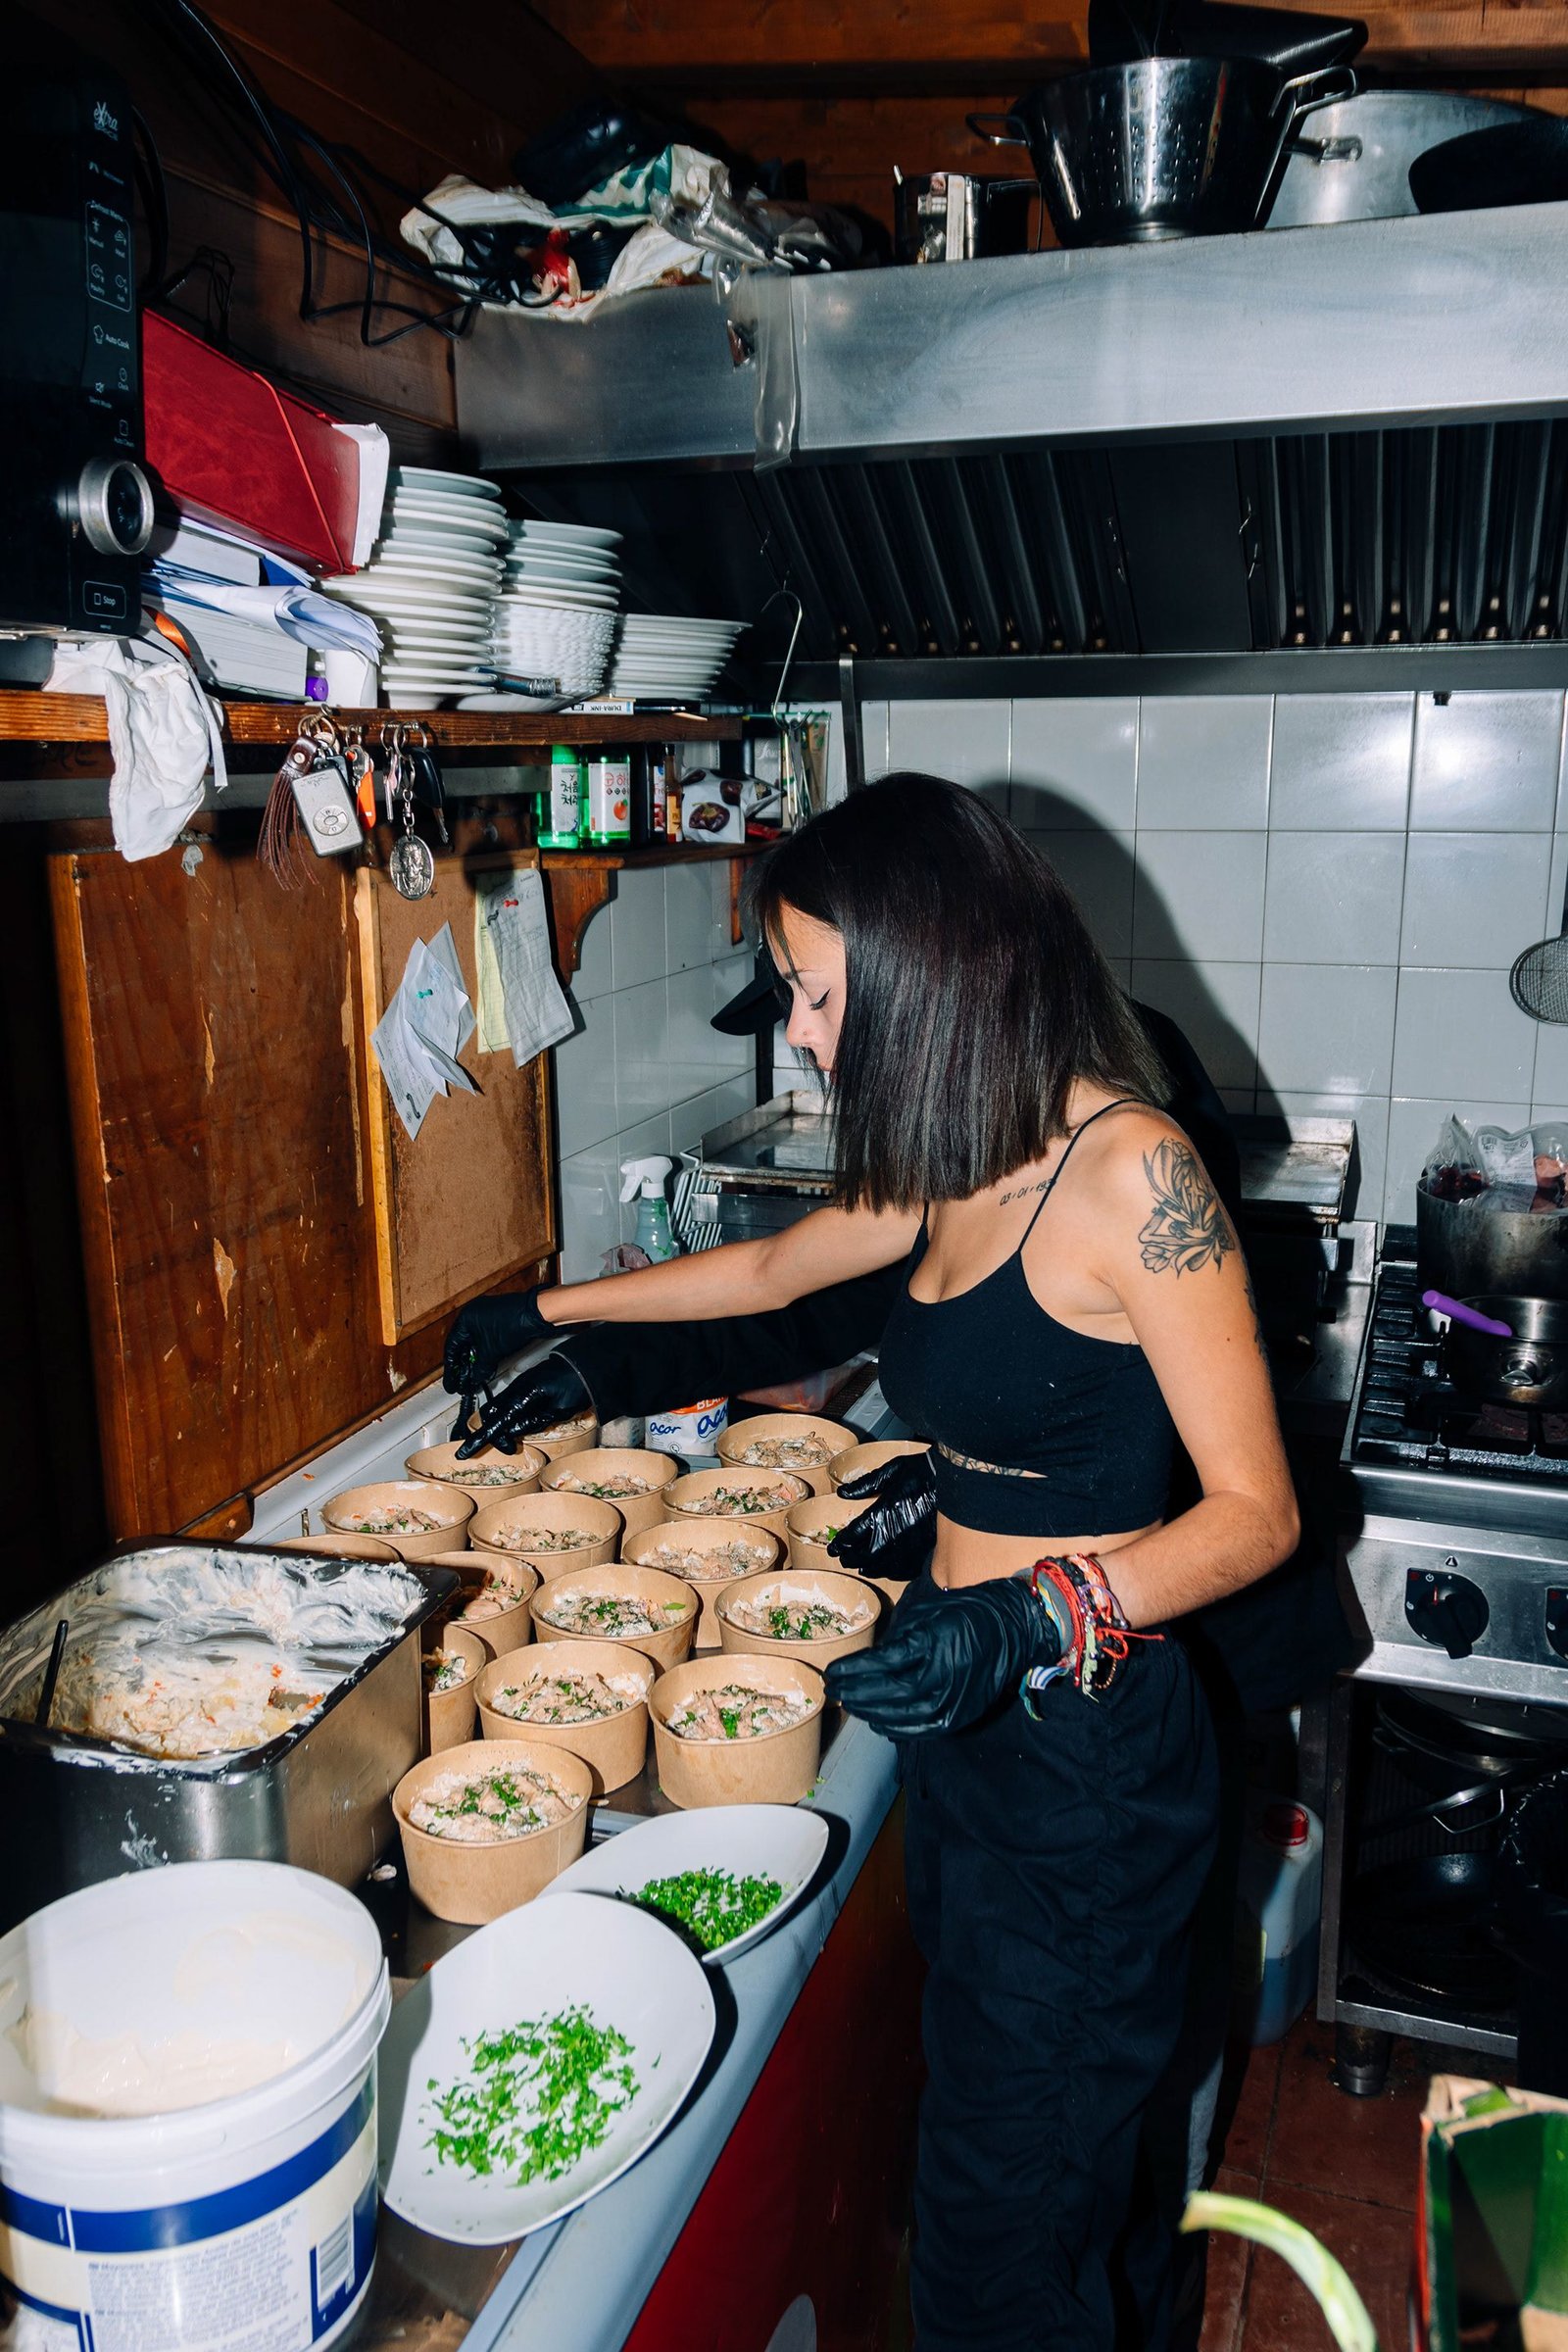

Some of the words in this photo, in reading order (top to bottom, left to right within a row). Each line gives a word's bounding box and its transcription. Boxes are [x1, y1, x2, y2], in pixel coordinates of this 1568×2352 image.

[105, 333, 118, 345] Auto
[118, 338, 130, 350] Cook
[103, 595, 116, 608] Stop
[697, 1404, 729, 1436] aco
